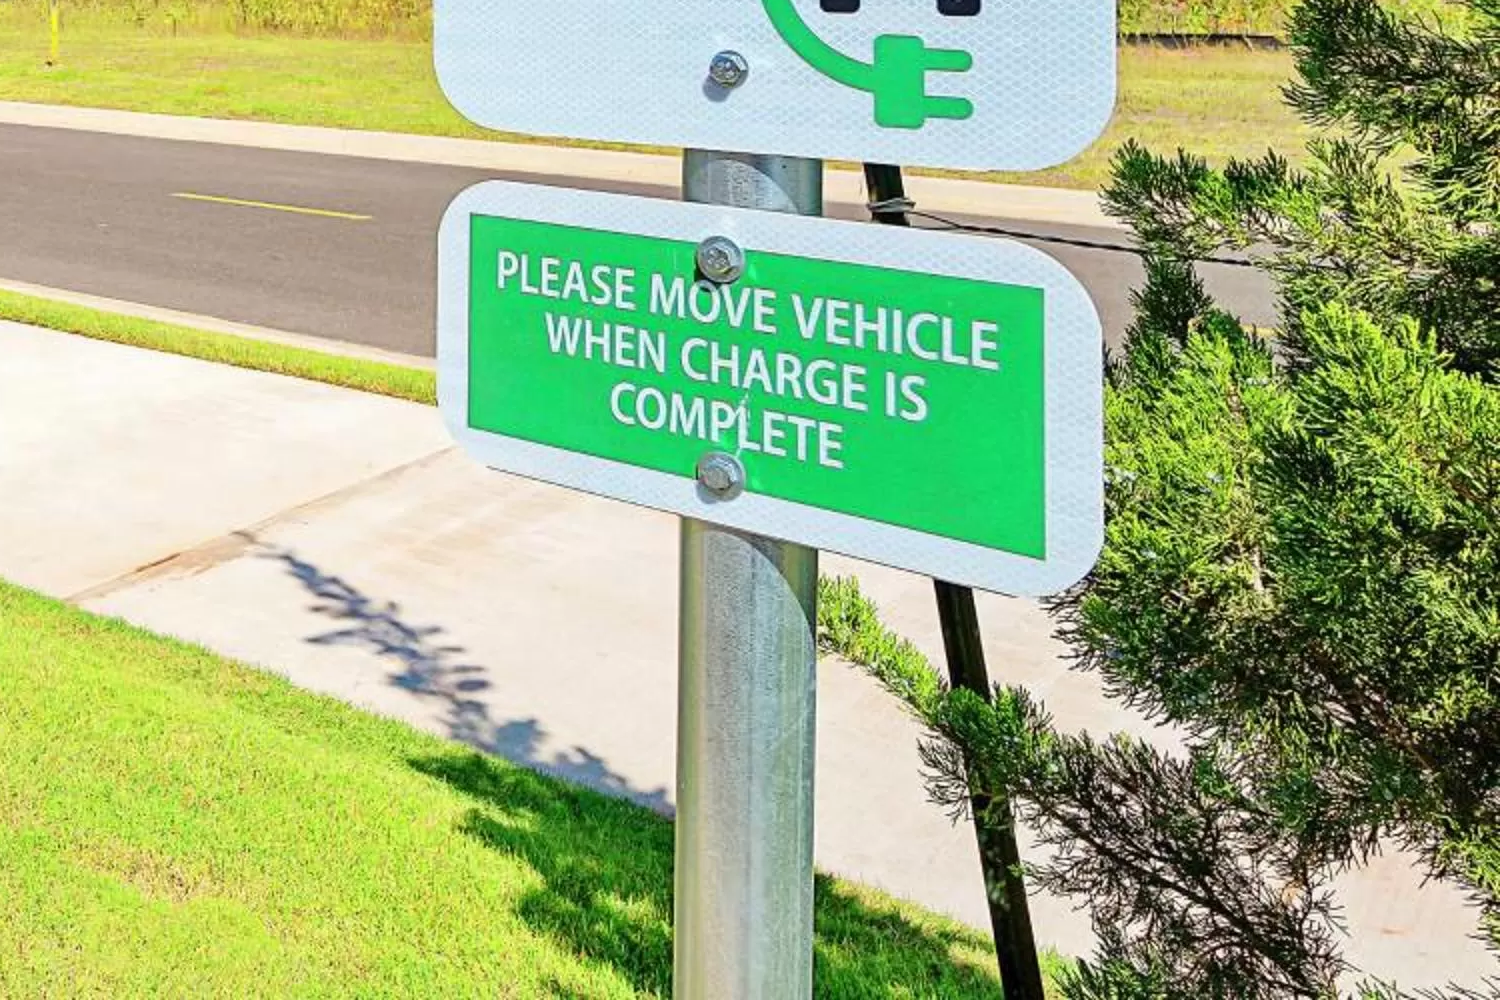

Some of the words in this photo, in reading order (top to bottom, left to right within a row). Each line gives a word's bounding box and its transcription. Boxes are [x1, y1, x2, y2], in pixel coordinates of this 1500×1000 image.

[497, 250, 636, 311] PLEASE
[649, 273, 777, 335] MOVE
[791, 294, 1001, 372] VEHICLE
[545, 312, 667, 373] WHEN
[680, 337, 870, 413] CHARGE
[885, 370, 930, 424] IS
[610, 381, 845, 470] COMPLETE
